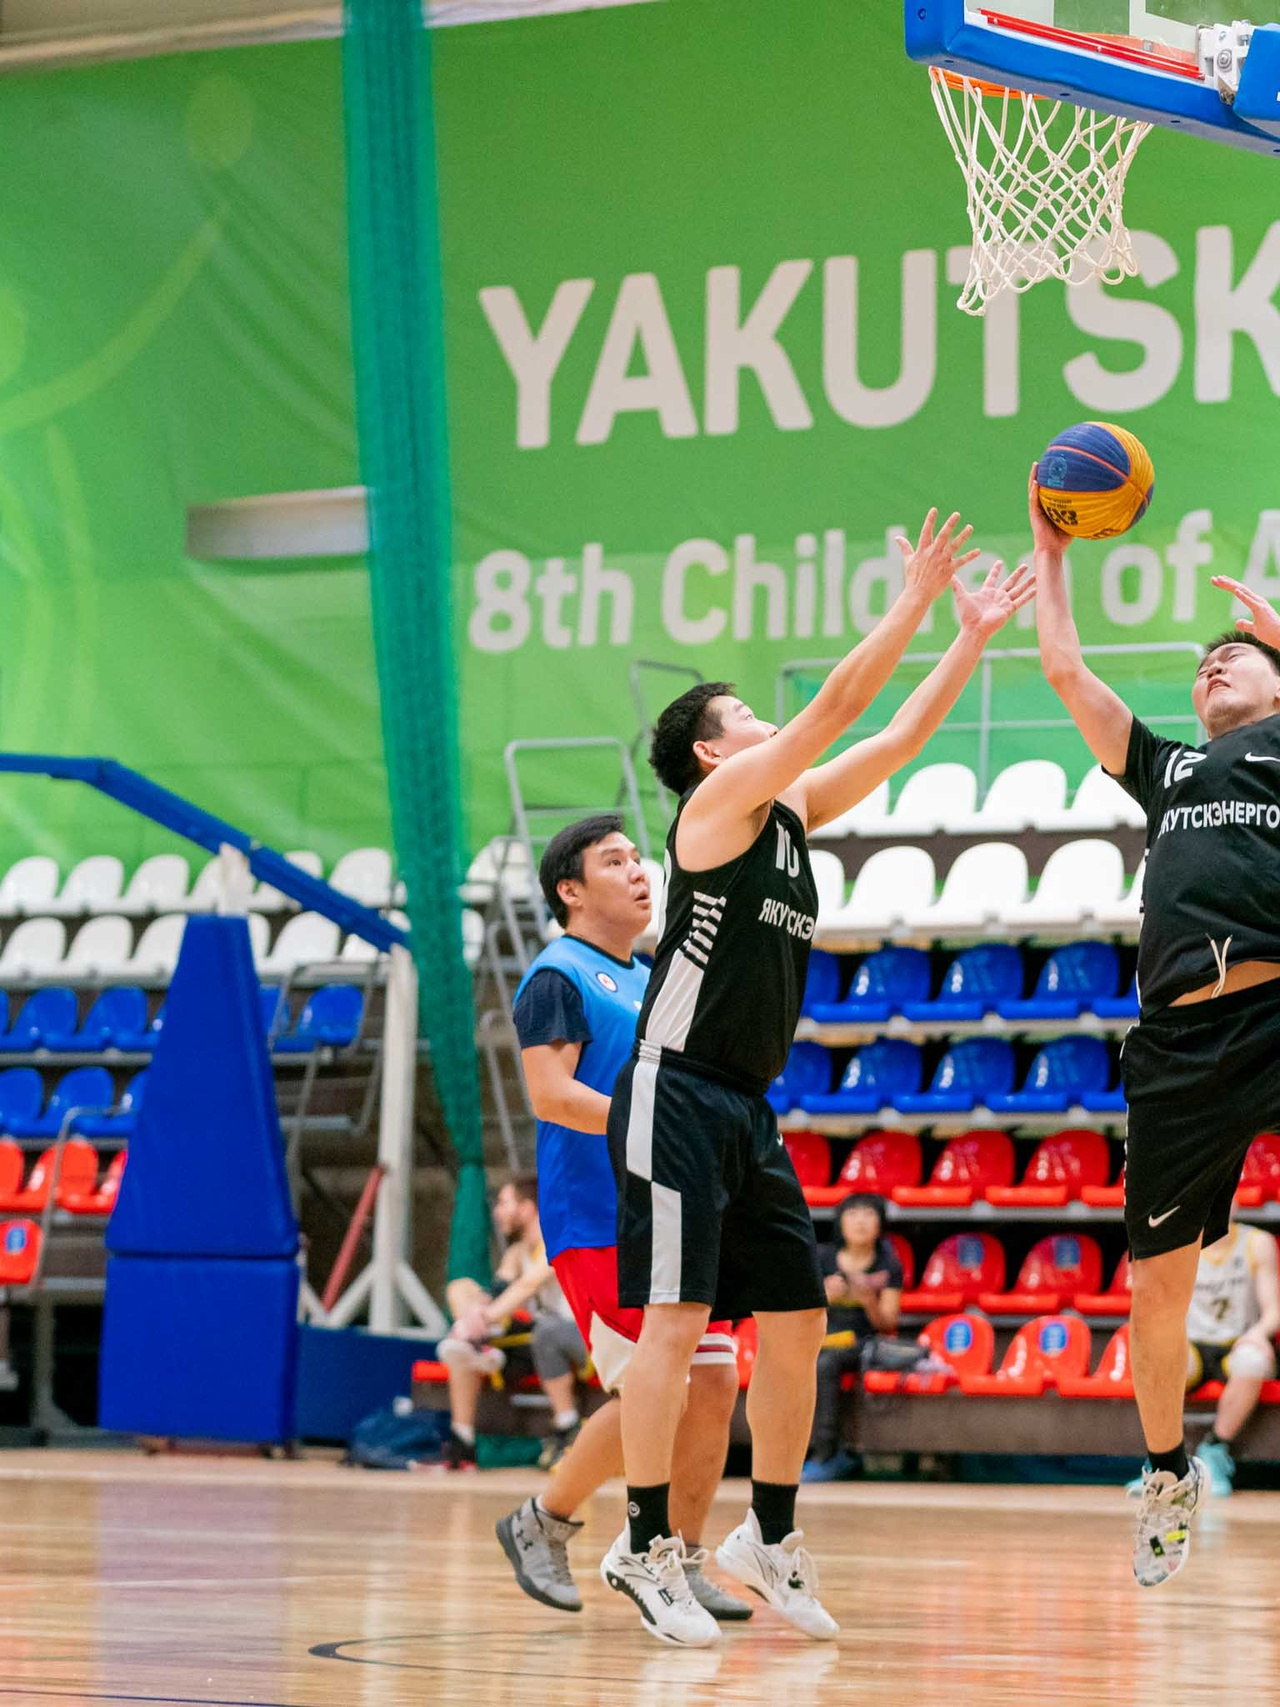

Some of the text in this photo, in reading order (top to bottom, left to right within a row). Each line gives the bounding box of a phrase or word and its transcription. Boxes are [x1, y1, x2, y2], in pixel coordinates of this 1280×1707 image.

[467, 542, 635, 653] 8th
[660, 525, 1073, 646] Child
[1103, 508, 1213, 627] of
[1164, 748, 1207, 789] 12
[775, 820, 800, 878] 10
[758, 898, 815, 940] ЯКУСКЭ
